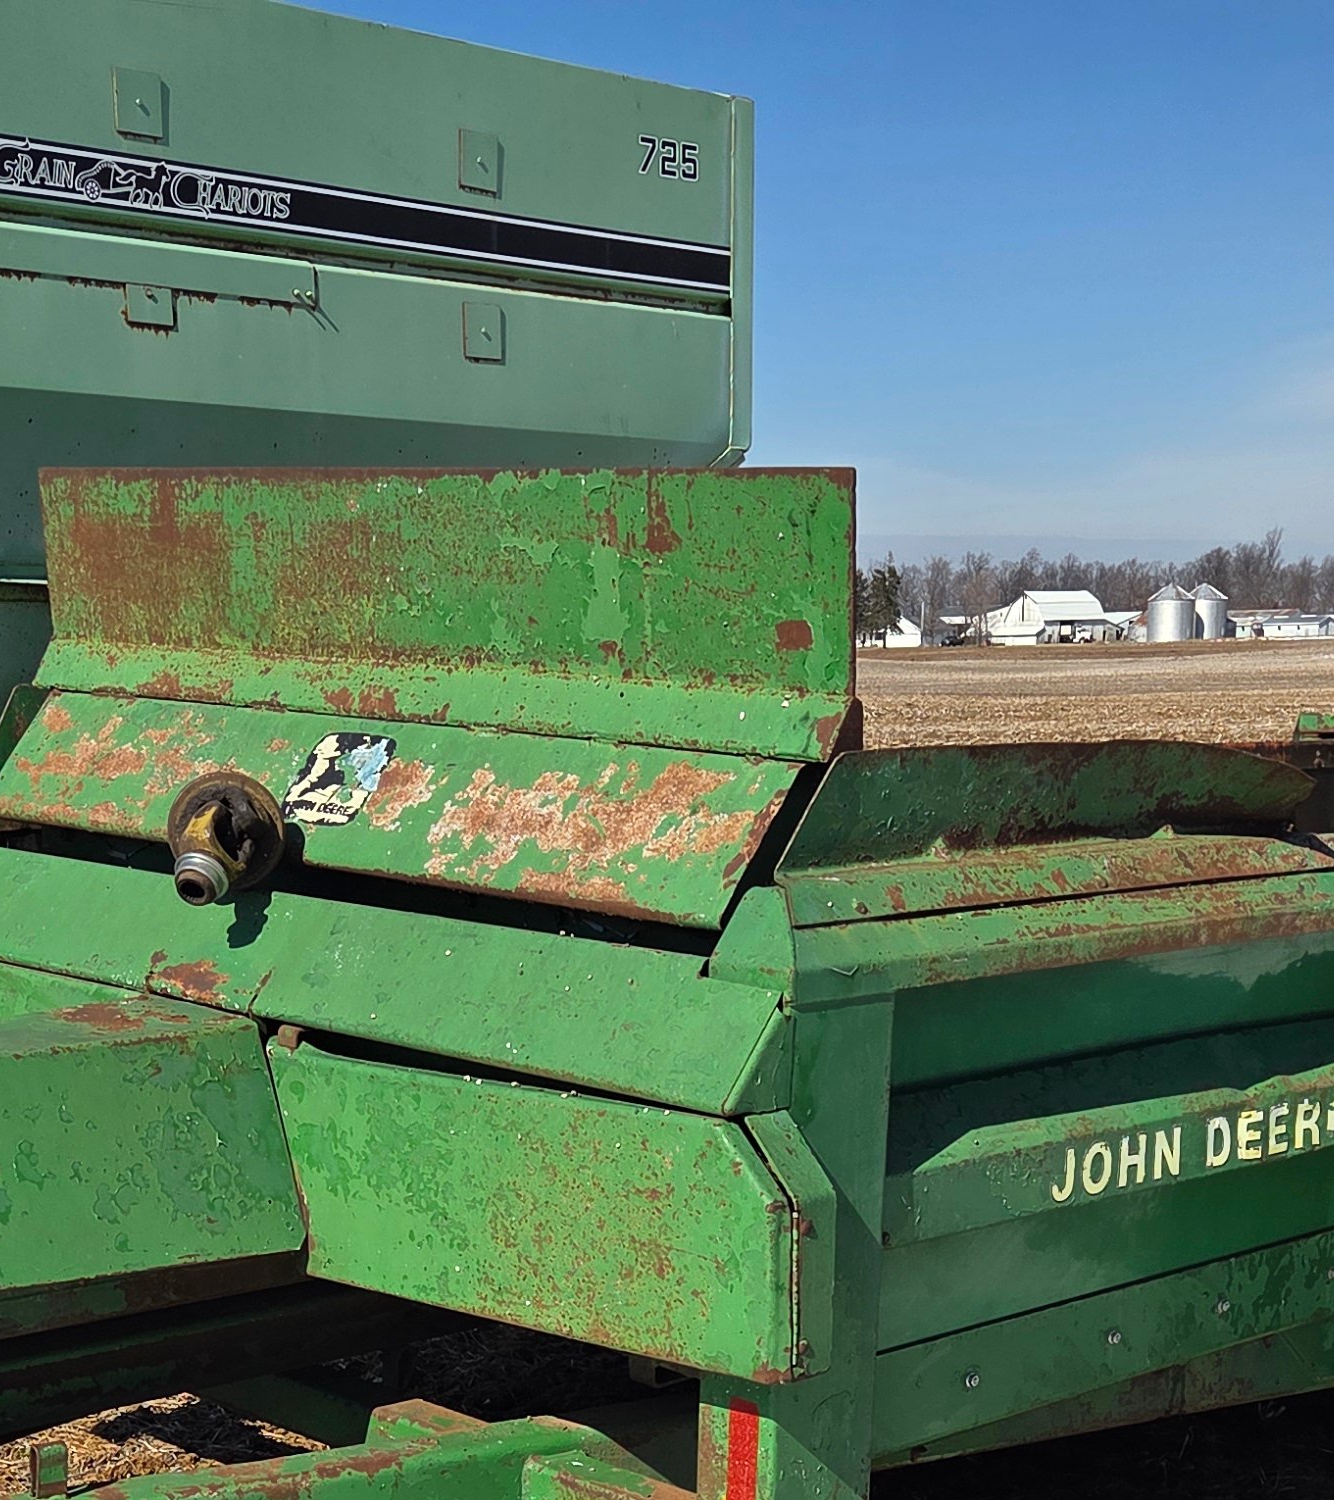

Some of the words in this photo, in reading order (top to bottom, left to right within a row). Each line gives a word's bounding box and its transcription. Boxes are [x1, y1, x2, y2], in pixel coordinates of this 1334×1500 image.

[638, 134, 699, 181] 725
[170, 171, 291, 220] CHARIOTS
[1051, 1123, 1182, 1203] JOHN
